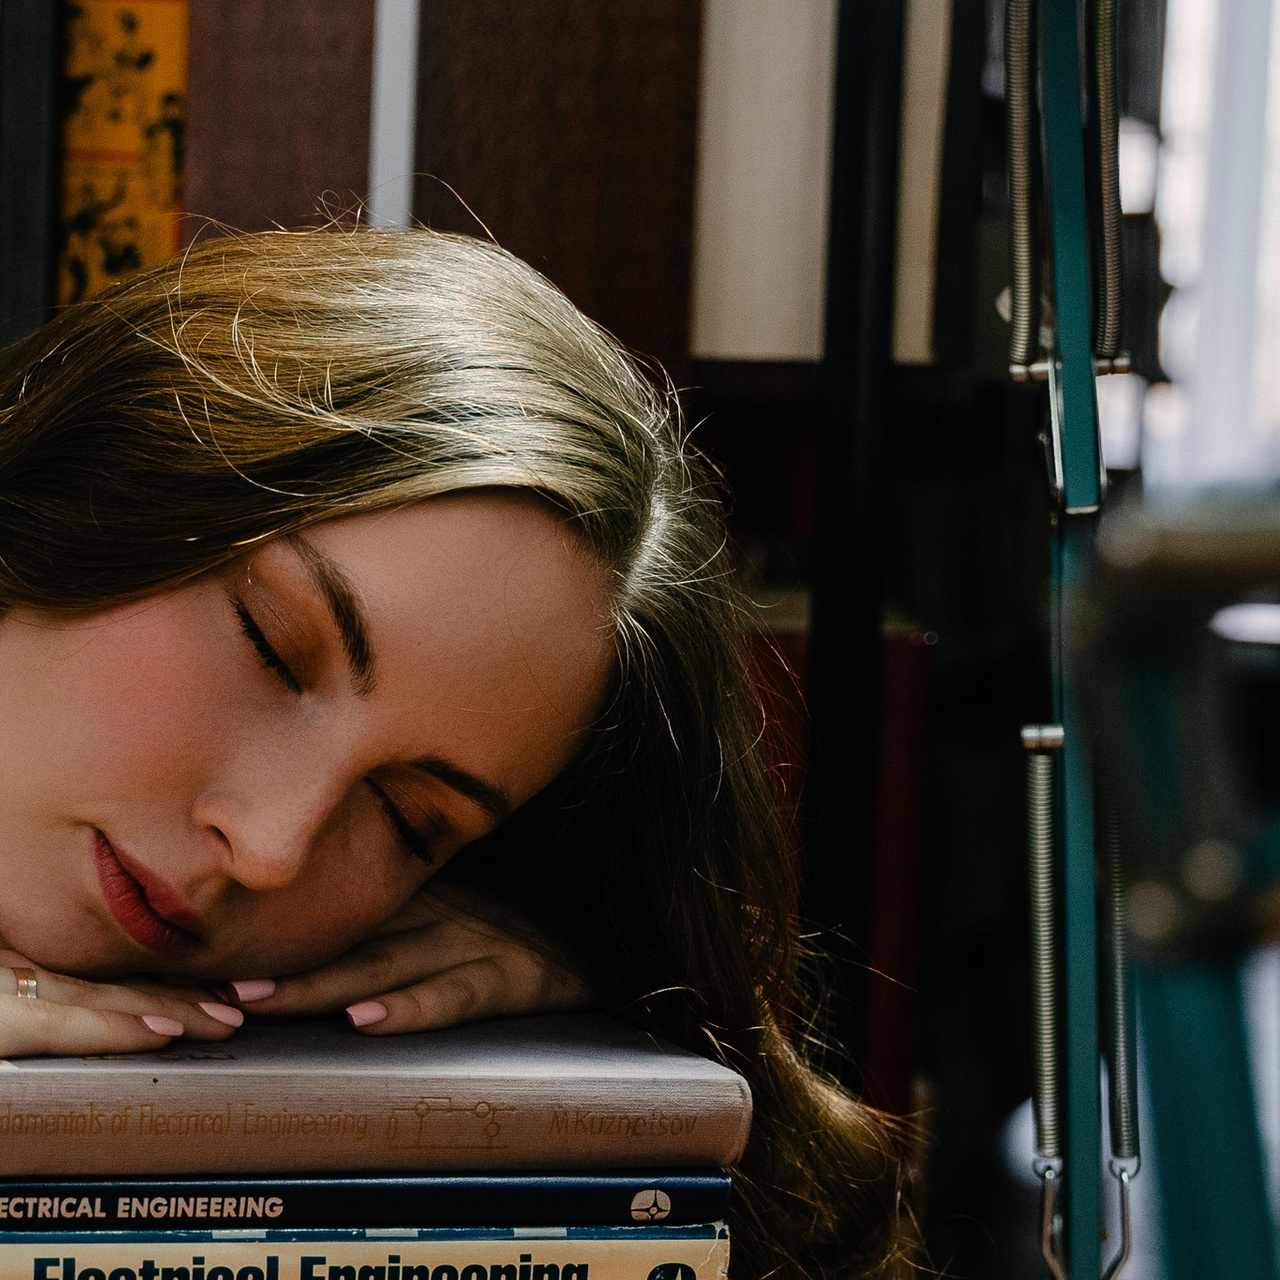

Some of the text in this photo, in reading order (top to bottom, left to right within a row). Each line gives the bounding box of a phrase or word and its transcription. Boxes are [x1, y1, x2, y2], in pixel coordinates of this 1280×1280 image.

[111, 1105, 132, 1136] of
[138, 1102, 232, 1136] Electrical
[241, 1102, 368, 1142] Engineering
[116, 1196, 285, 1219] ENGINEERING
